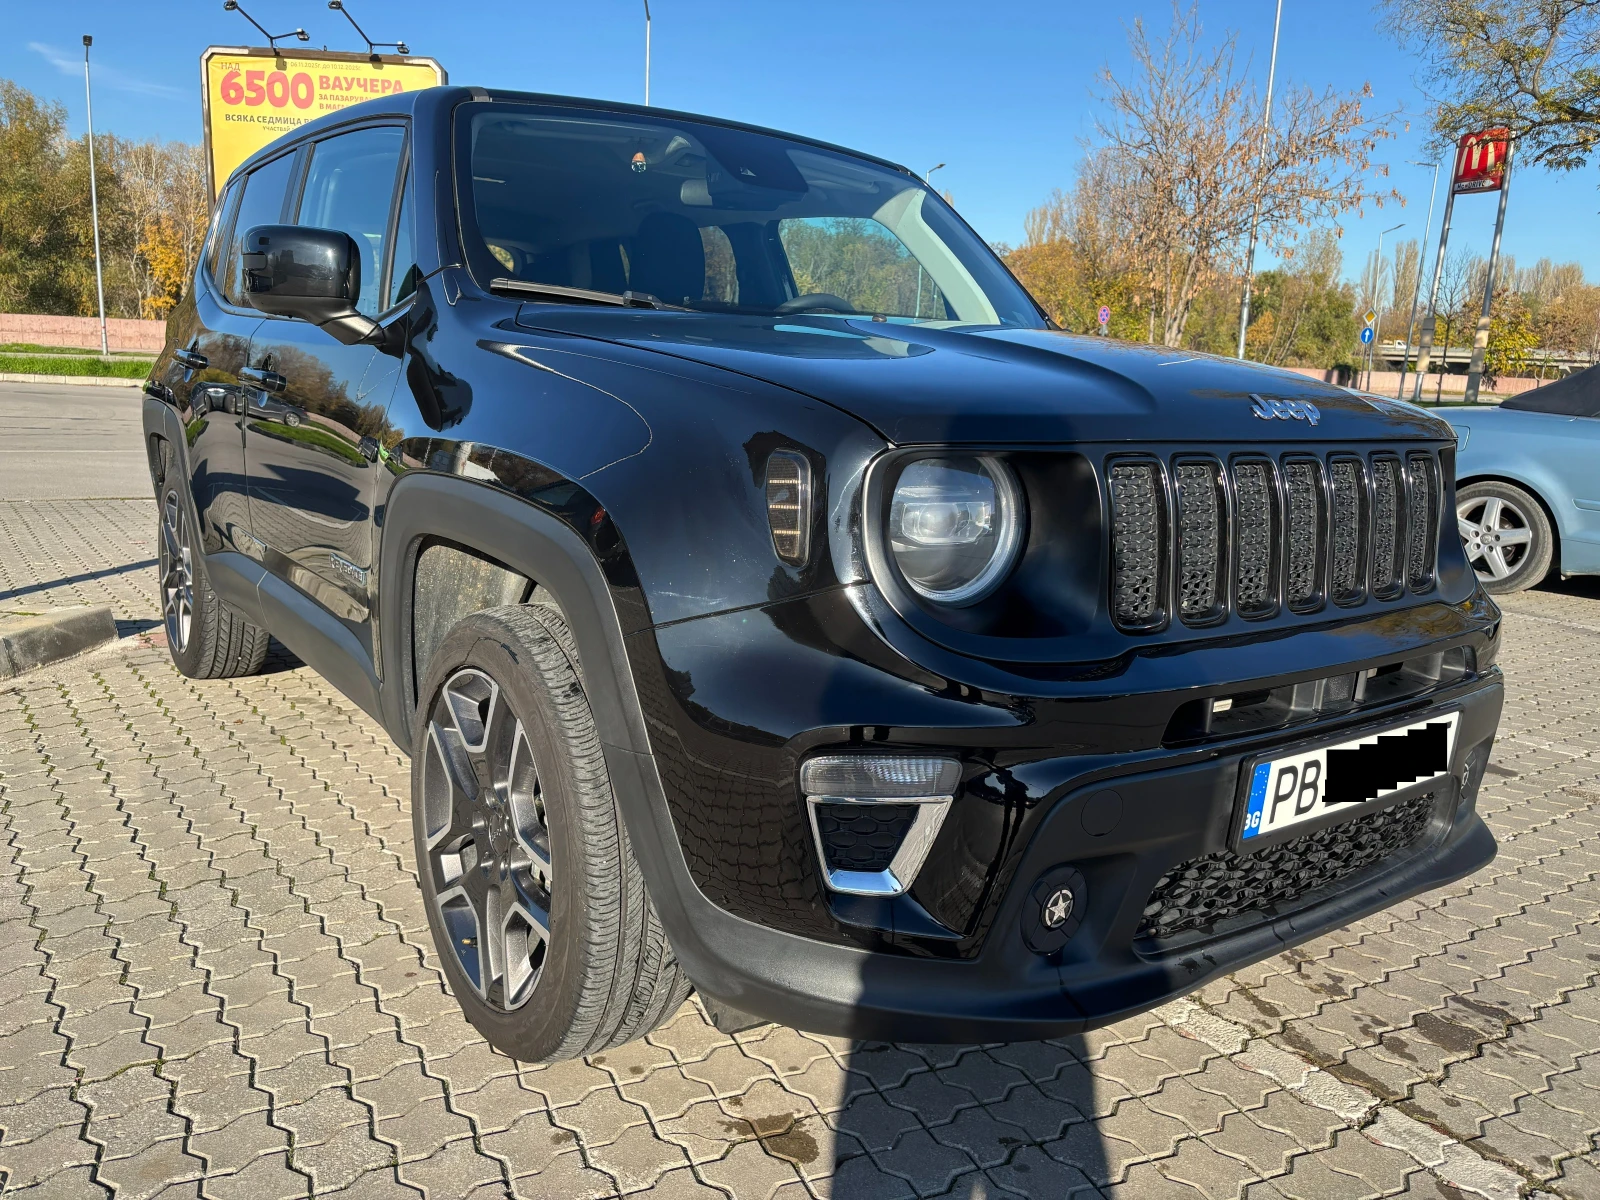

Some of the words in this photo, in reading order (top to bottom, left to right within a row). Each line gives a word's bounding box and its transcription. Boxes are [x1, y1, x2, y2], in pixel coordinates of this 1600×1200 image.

[220, 62, 240, 71] НАД
[220, 70, 314, 109] 6500
[318, 75, 404, 94] ВАУЧЕРА
[225, 114, 255, 123] ВСЯКА
[256, 116, 302, 125] СЕДМИЦА
[1248, 394, 1320, 426] Jeep
[1268, 759, 1321, 825] PB
